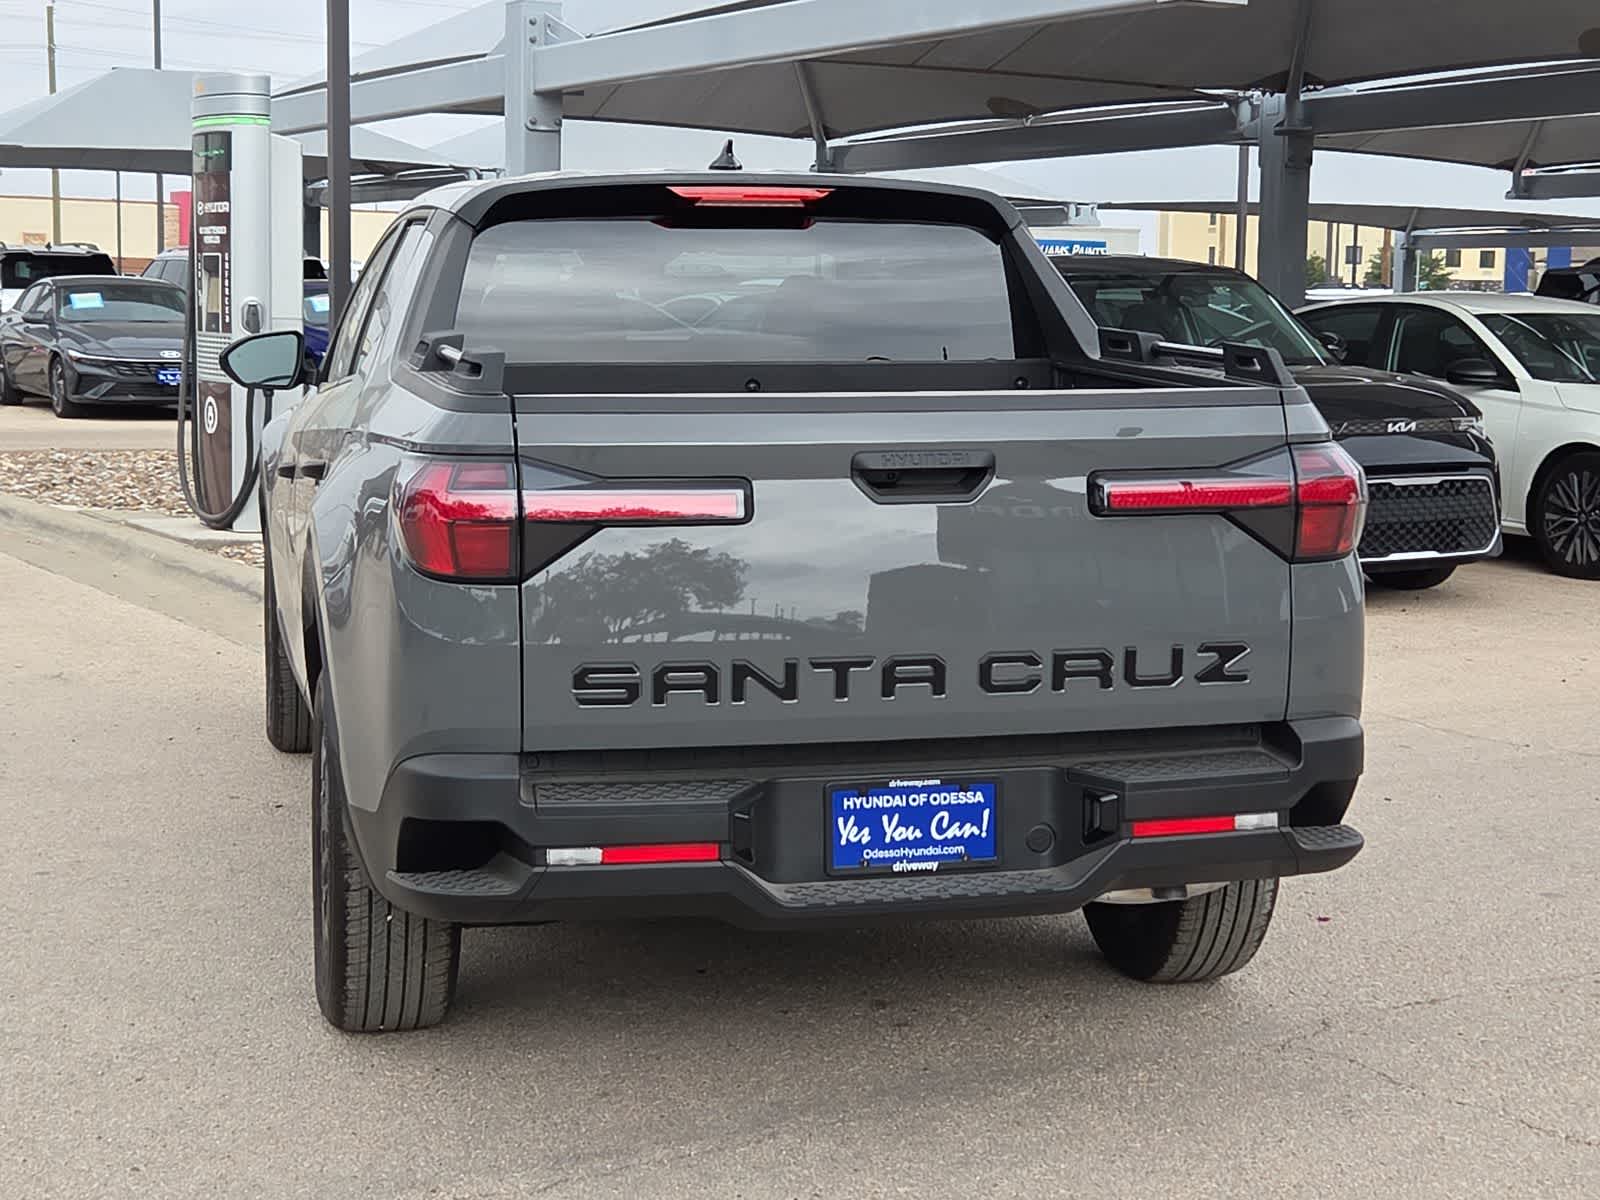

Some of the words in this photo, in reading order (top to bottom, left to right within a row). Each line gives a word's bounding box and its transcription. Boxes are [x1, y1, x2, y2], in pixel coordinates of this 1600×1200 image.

[1387, 421, 1417, 433] KIA
[571, 653, 949, 709] SANTA
[977, 640, 1252, 696] CRUZ
[888, 779, 941, 788] driveway.com
[843, 795, 906, 810] HYUNDAI
[908, 794, 928, 807] OF
[929, 791, 985, 806] ODESSA
[837, 815, 872, 846] Yes
[881, 812, 923, 844] You
[930, 807, 990, 841] Can!
[863, 845, 965, 860] OdessaHyundai.com
[892, 859, 940, 873] driveway
